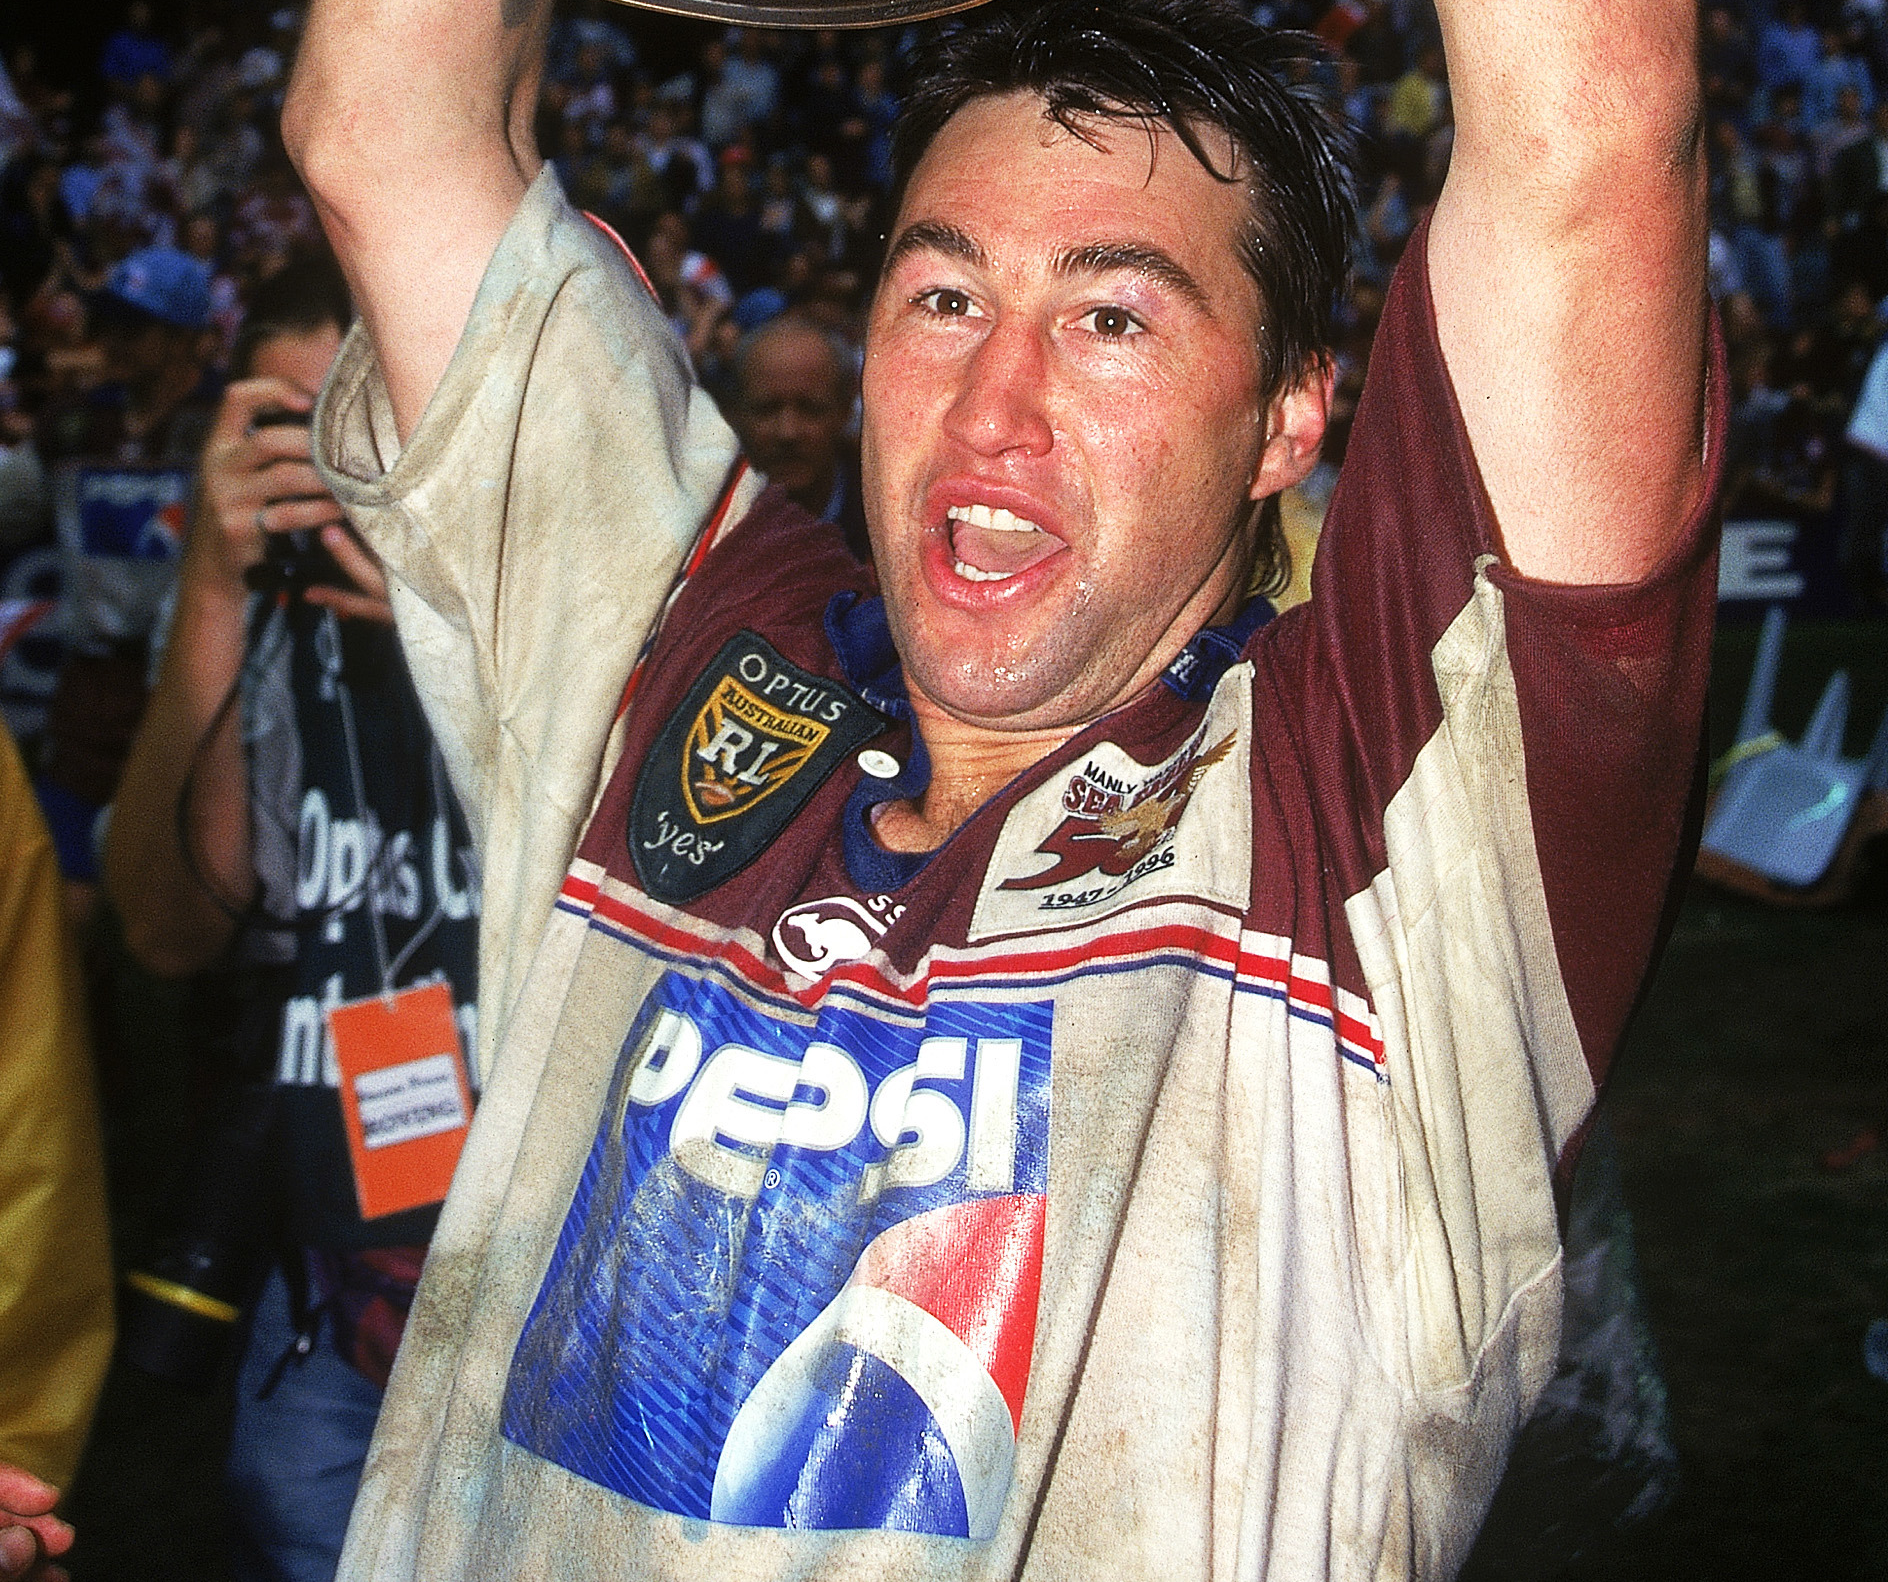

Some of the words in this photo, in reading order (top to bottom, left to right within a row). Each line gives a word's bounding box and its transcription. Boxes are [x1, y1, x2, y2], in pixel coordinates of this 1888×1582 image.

[721, 685, 821, 742] AUSTRALIAN
[738, 653, 848, 722] OPTUS
[697, 717, 780, 786] RL
[1082, 760, 1138, 794] MANLY
[1062, 775, 1124, 816] SEA
[628, 1005, 1023, 1206] PEPSI
